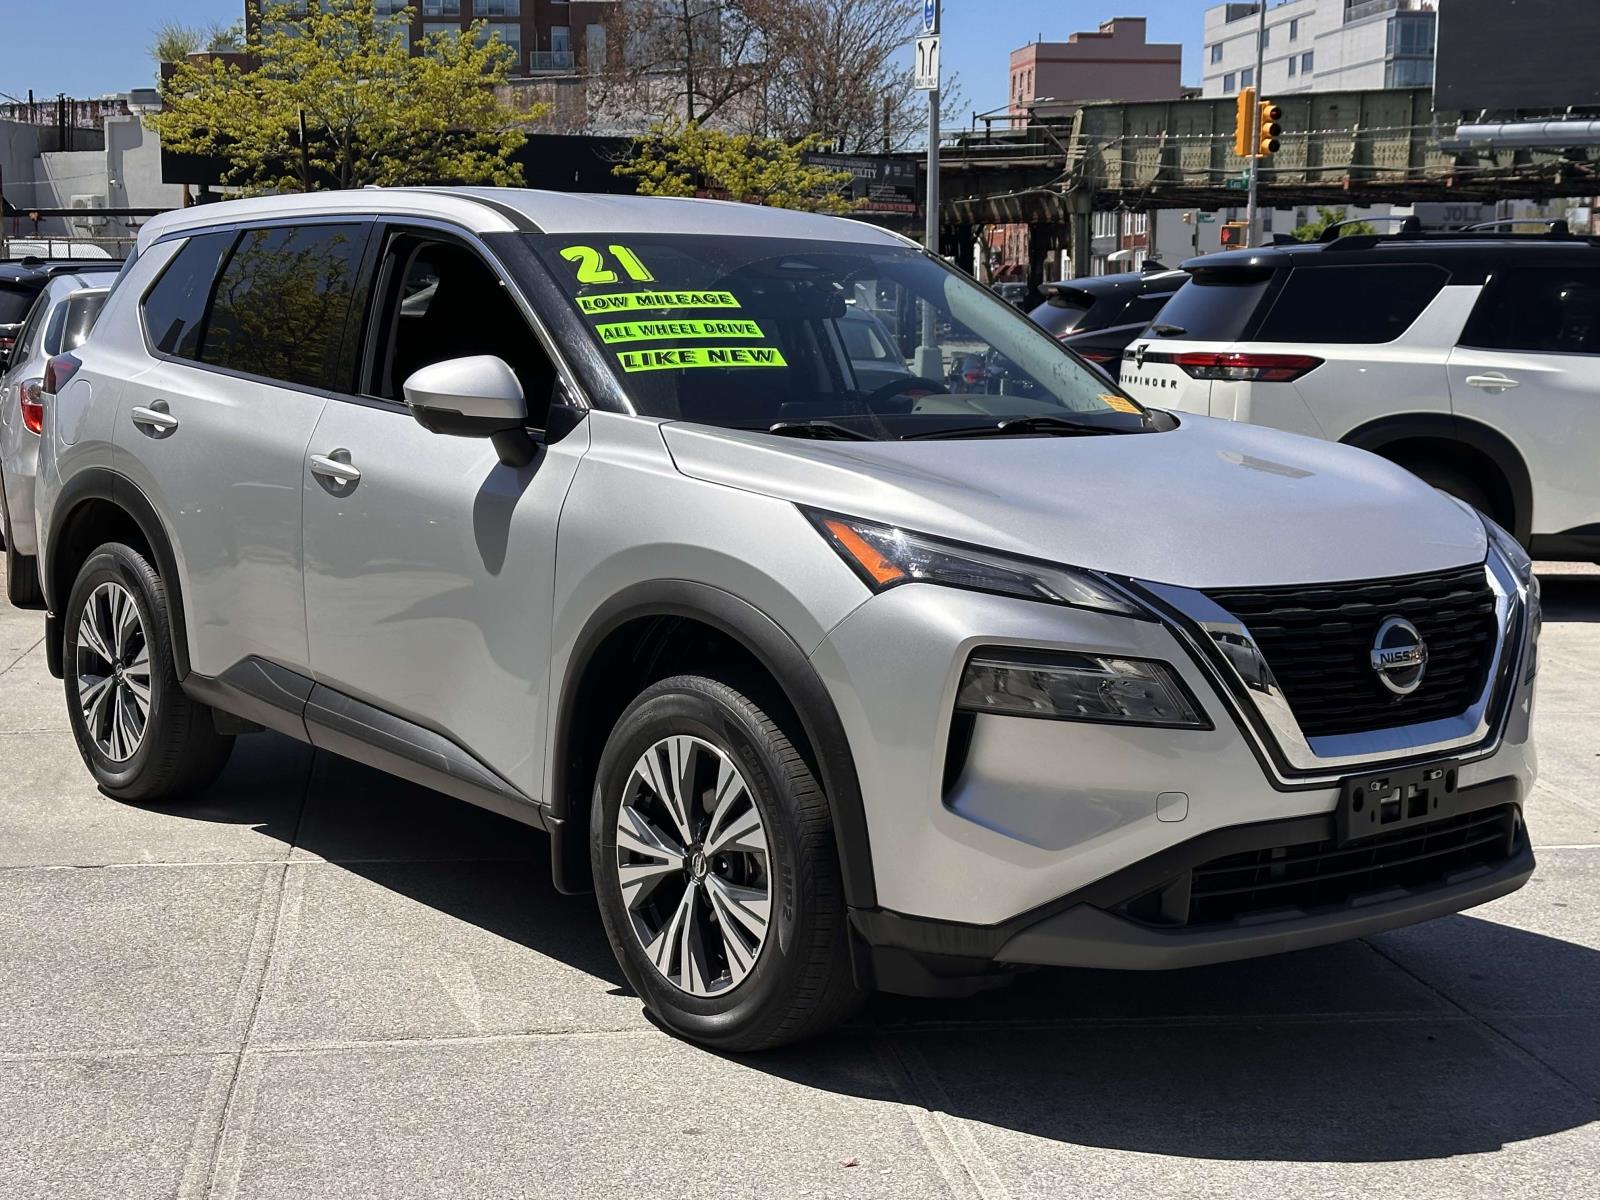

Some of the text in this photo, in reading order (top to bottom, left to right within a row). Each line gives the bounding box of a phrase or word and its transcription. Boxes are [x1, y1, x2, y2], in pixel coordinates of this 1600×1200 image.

[560, 245, 655, 284] 21
[582, 293, 733, 310] LOW MILEAGE
[604, 323, 758, 339] ALL WHEEL DRIVE
[623, 349, 774, 367] LIKE NEW
[1119, 374, 1178, 389] ATHFINDER
